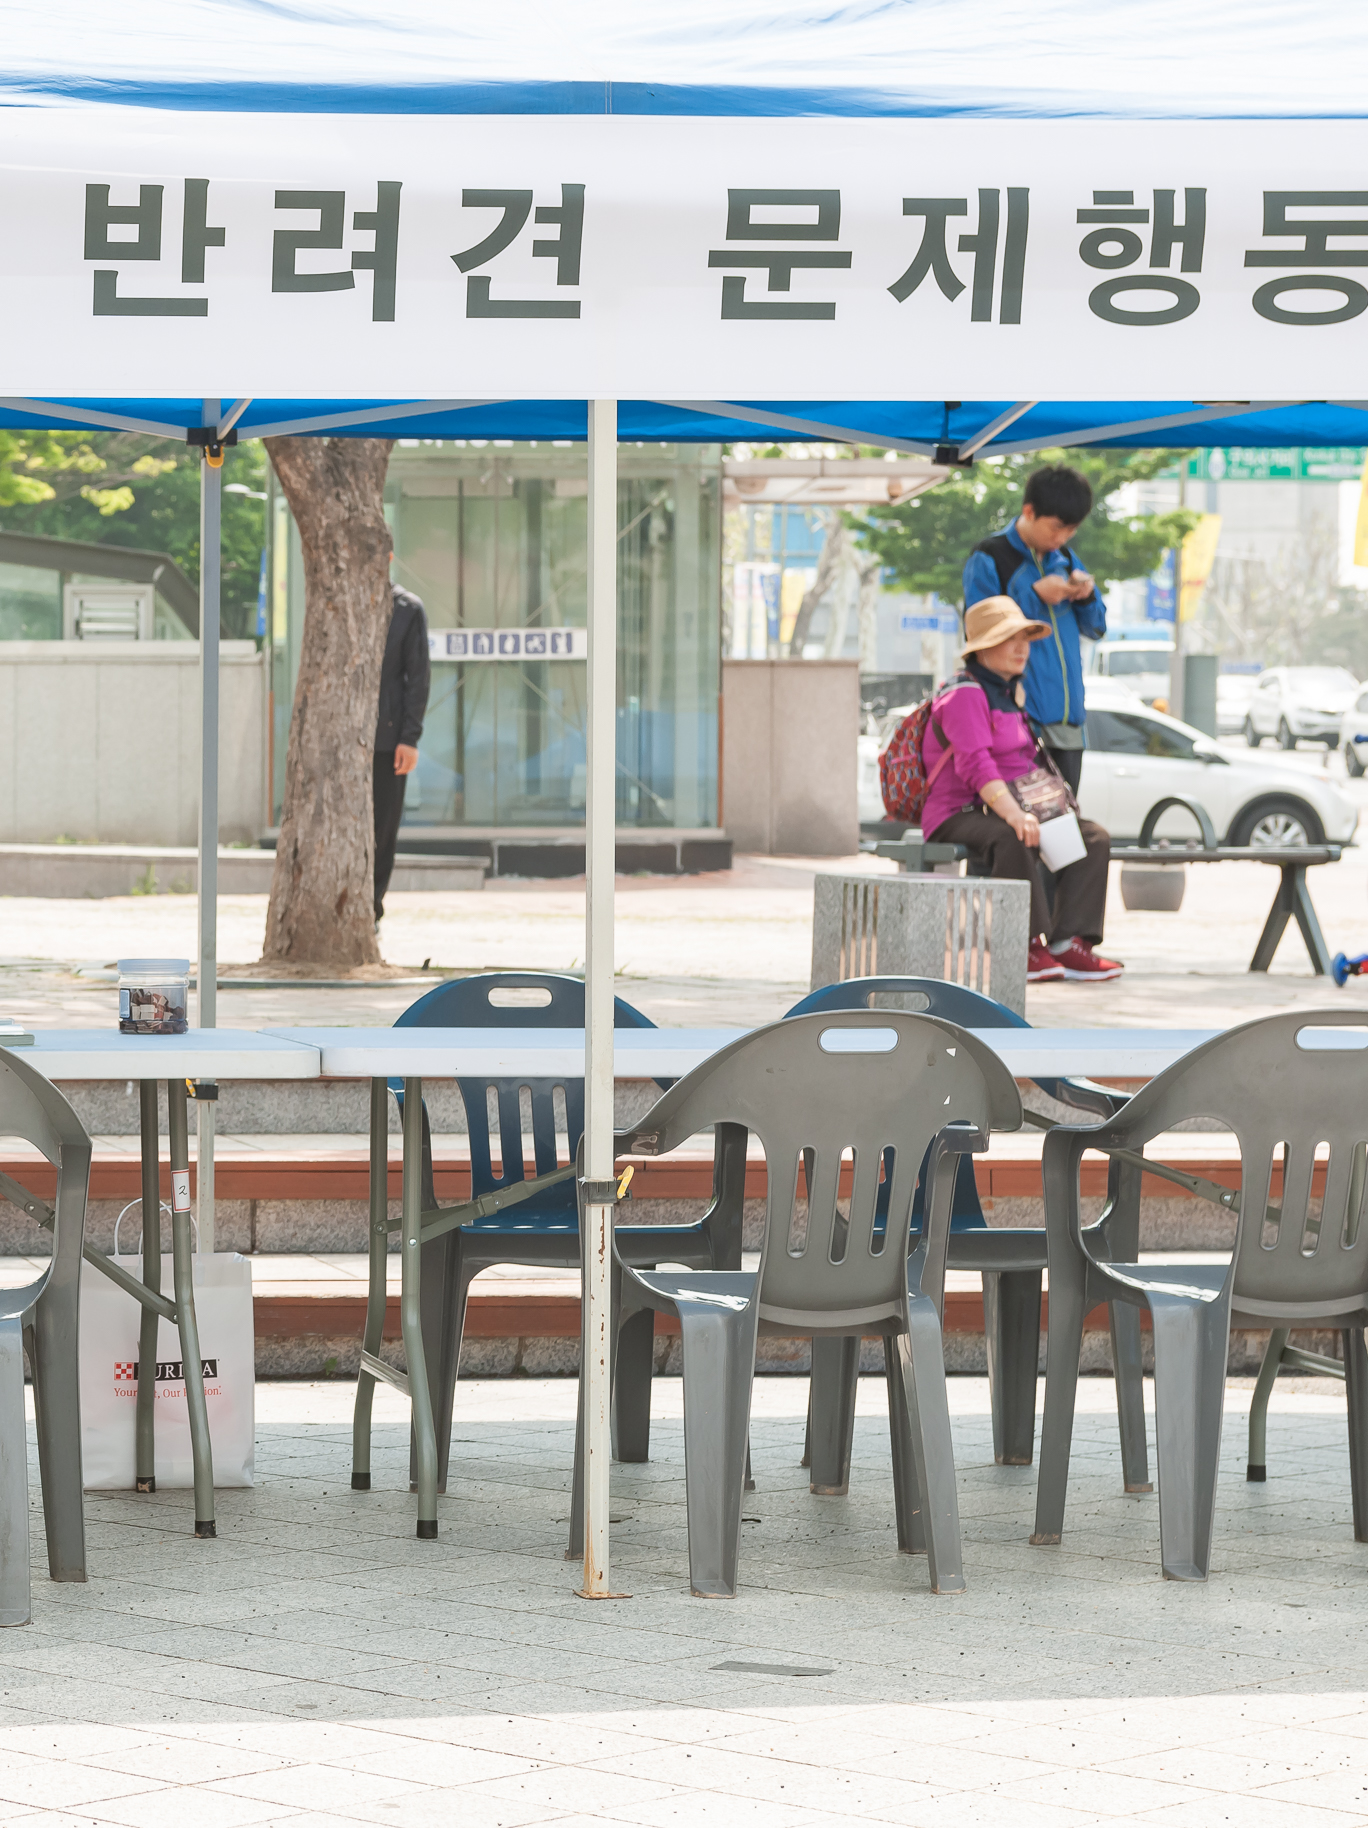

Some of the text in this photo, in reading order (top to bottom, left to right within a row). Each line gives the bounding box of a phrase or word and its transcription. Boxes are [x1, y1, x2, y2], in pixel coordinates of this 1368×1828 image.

[83, 177, 587, 322] 반려견
[707, 186, 1368, 327] 문제행동
[178, 1185, 188, 1196] 2
[135, 1361, 215, 1379] URIA
[162, 1388, 181, 1398] Our
